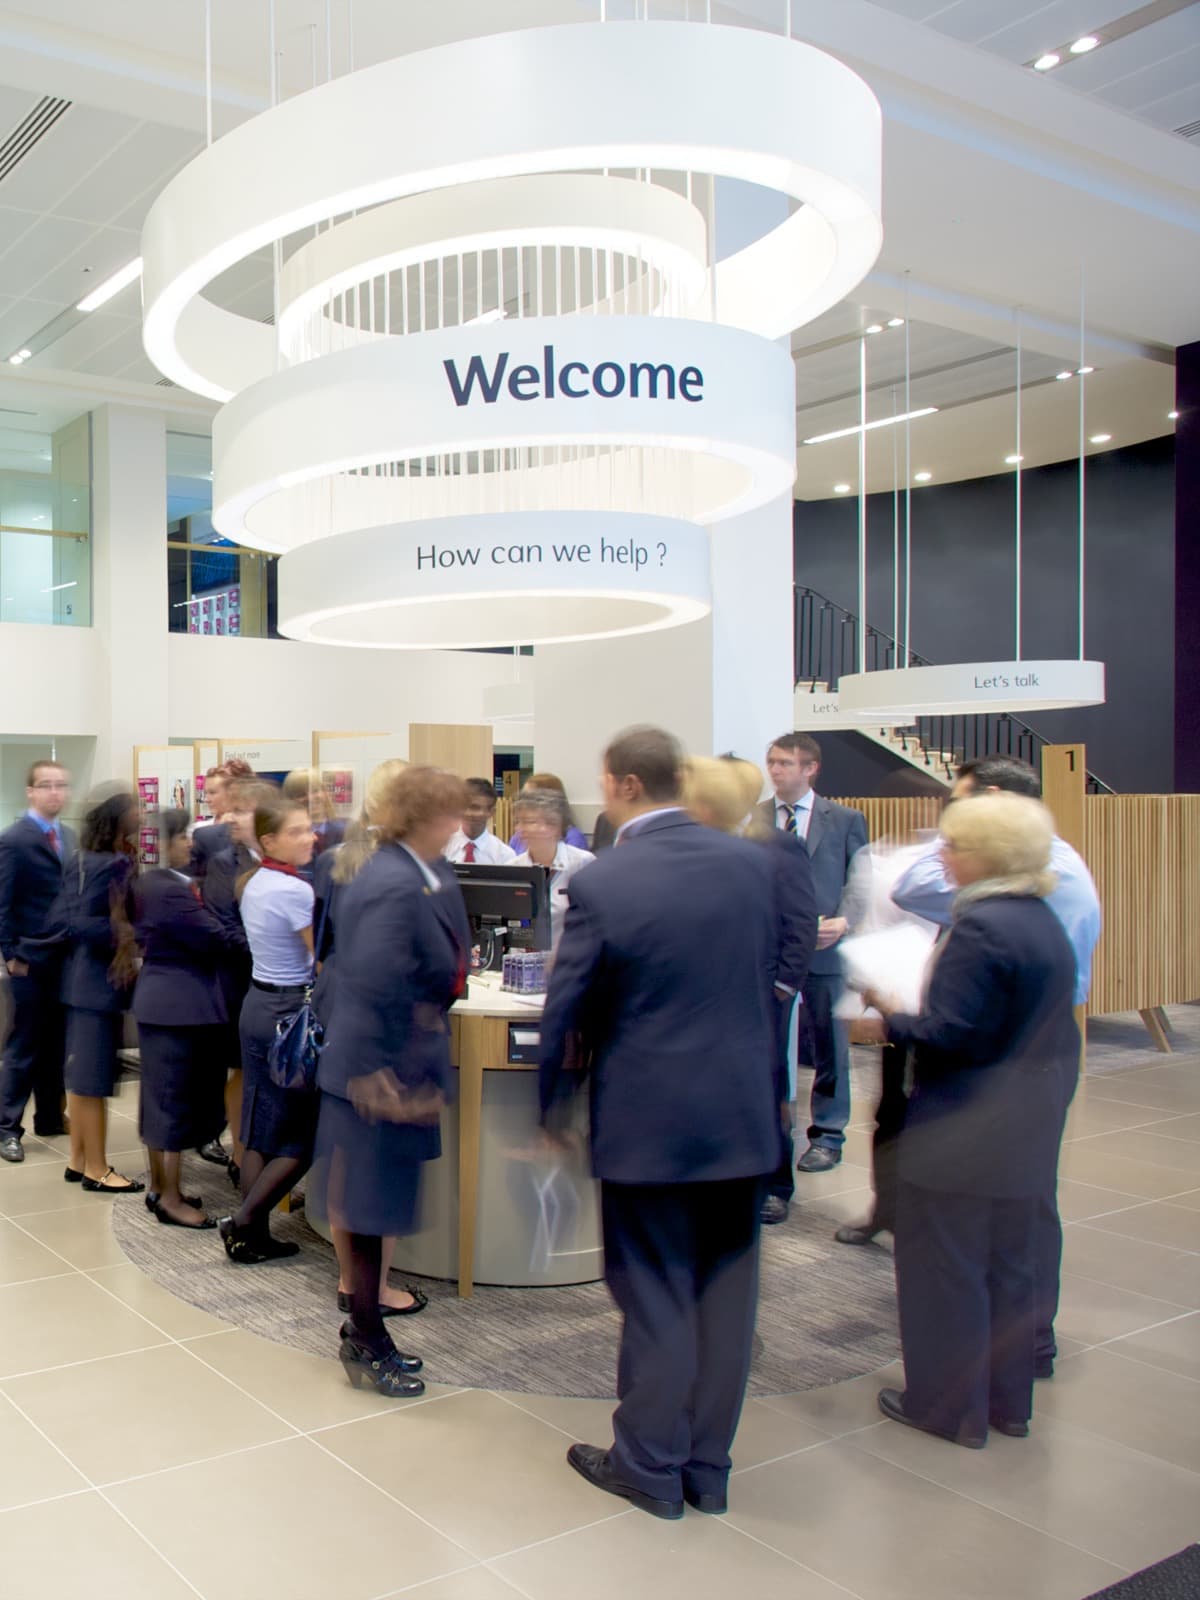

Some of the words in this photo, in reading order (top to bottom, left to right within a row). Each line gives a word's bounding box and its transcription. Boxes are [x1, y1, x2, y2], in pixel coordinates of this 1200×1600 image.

[442, 344, 704, 407] Welcome
[416, 544, 481, 570] How
[491, 544, 543, 565] can
[552, 543, 592, 564] we
[601, 536, 649, 572] help
[656, 541, 667, 567] ?
[974, 675, 1009, 689] Let's
[1015, 673, 1039, 687] talk
[1065, 750, 1075, 772] 1
[505, 774, 512, 785] 4
